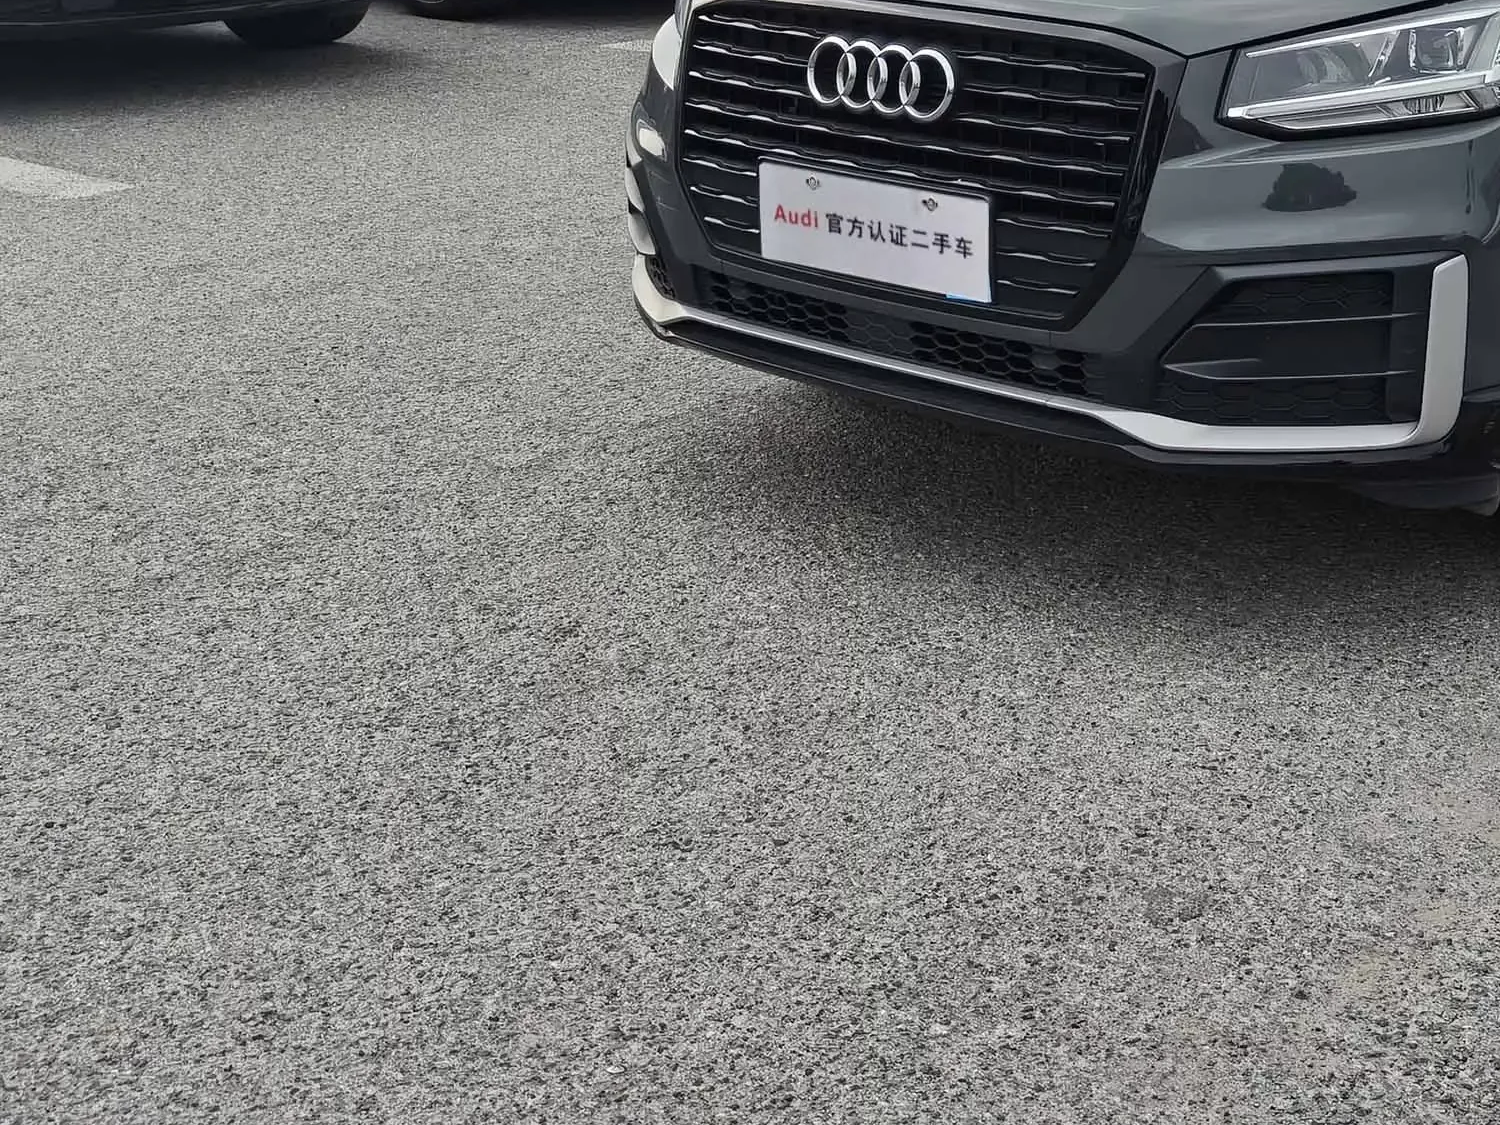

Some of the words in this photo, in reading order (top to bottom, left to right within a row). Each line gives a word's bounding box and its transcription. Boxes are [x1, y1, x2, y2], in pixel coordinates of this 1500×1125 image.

[774, 204, 819, 228] Audi
[825, 212, 974, 259] 官方认证二手车
